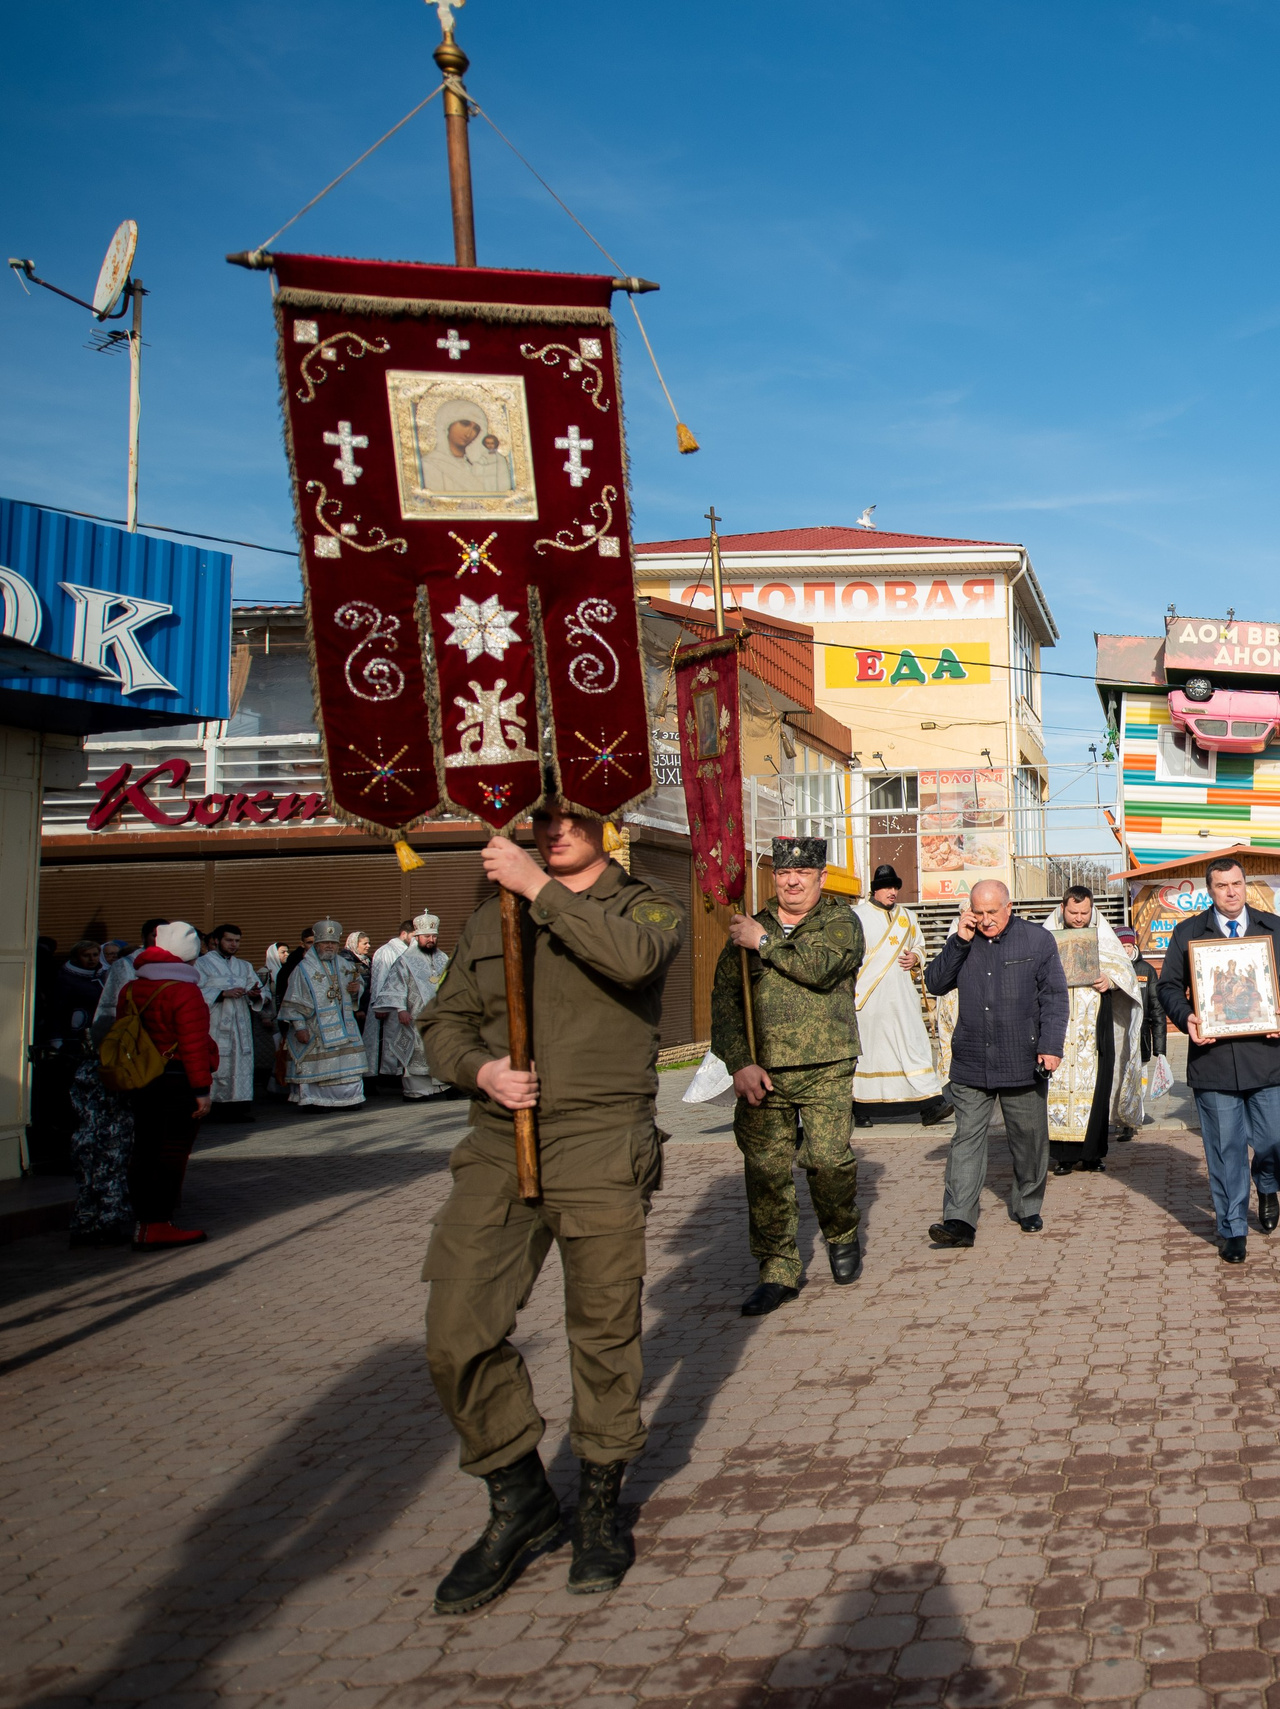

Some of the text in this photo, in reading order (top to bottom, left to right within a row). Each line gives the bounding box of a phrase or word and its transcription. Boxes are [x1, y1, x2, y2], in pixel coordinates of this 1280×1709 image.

[1179, 623, 1238, 645] ДОМ
[855, 648, 968, 686] ЕДА
[920, 773, 1003, 786] СТОЛОВАЯ
[939, 879, 983, 896] ЕД
